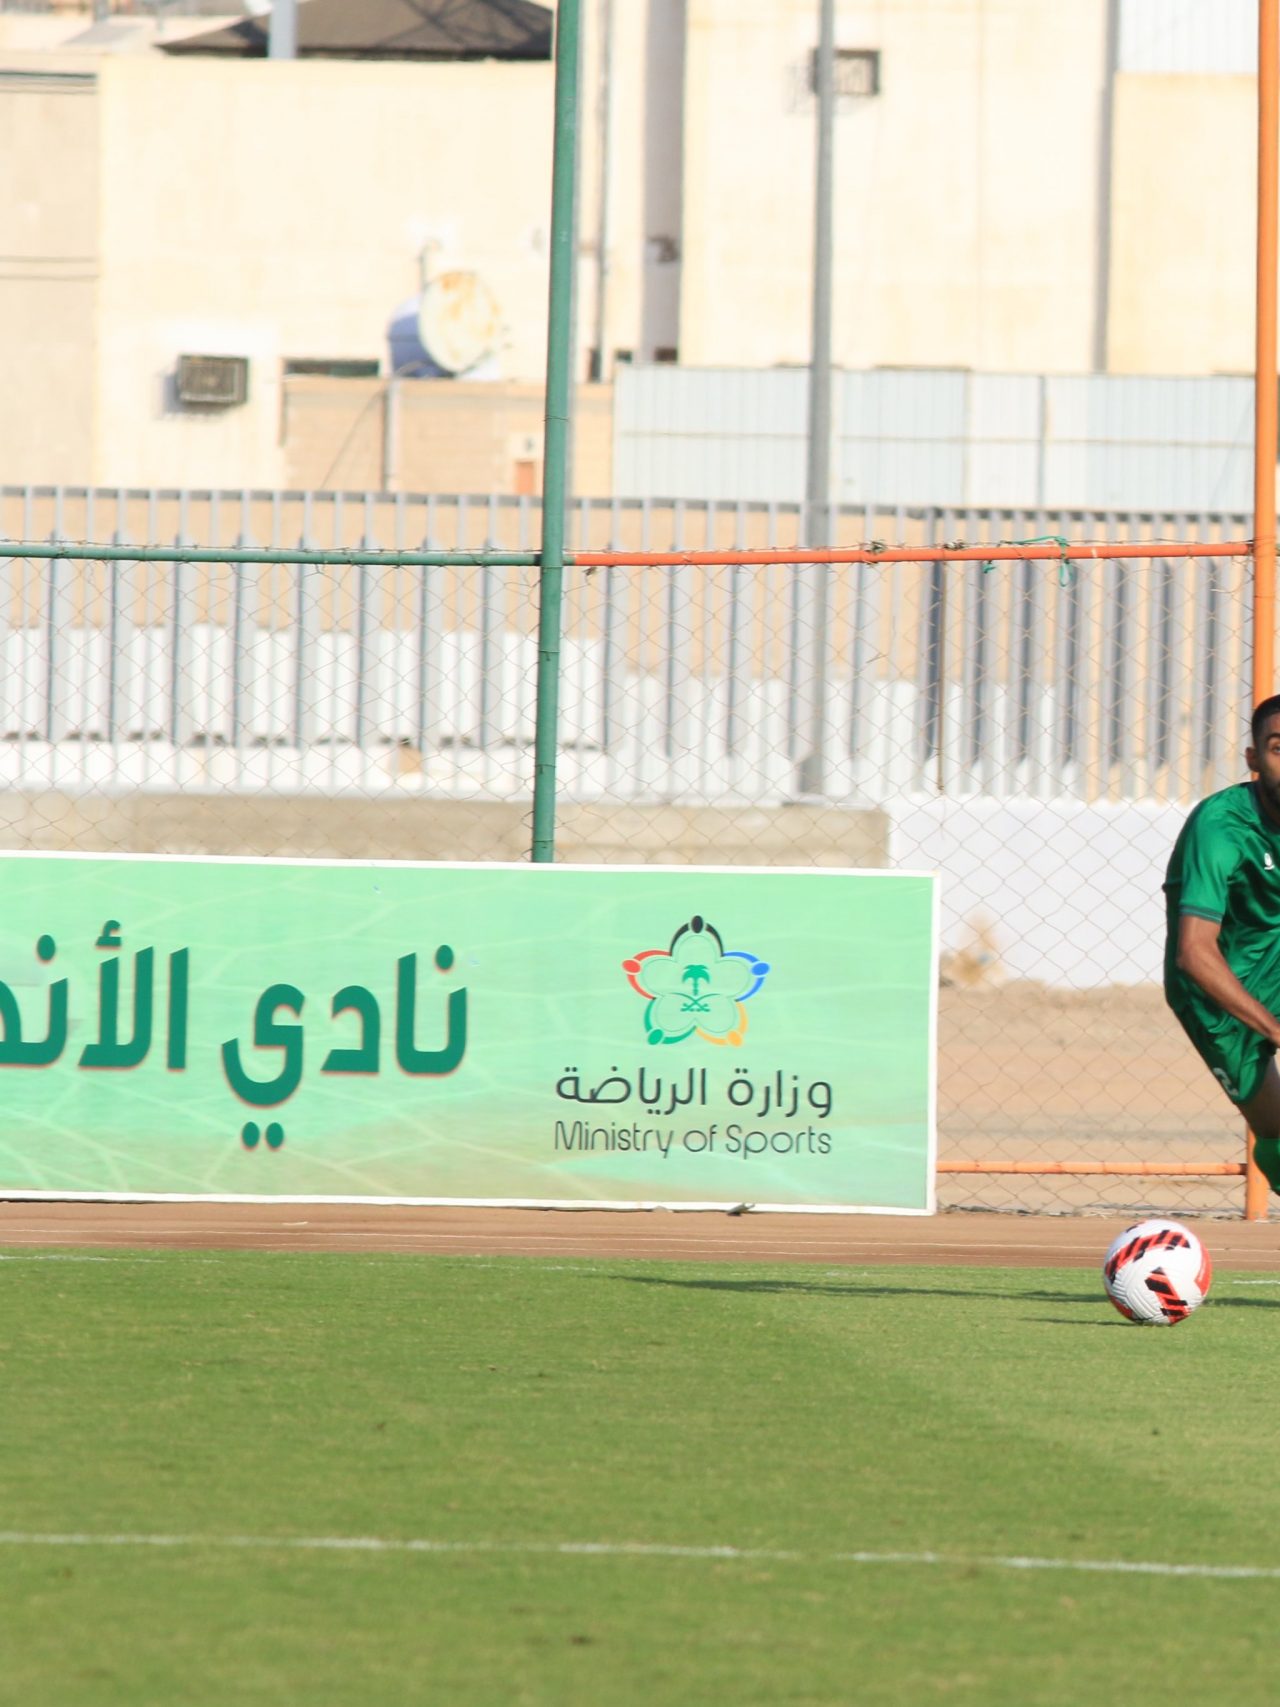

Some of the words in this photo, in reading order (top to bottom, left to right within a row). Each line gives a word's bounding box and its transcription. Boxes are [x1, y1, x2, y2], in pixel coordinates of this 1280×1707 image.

[220, 943, 468, 1150] نادي
[555, 1065, 707, 1116] الرياضة
[727, 1067, 833, 1119] وزارة
[554, 1119, 675, 1159] Ministry
[682, 1123, 718, 1153] of
[725, 1123, 832, 1160] Sports
